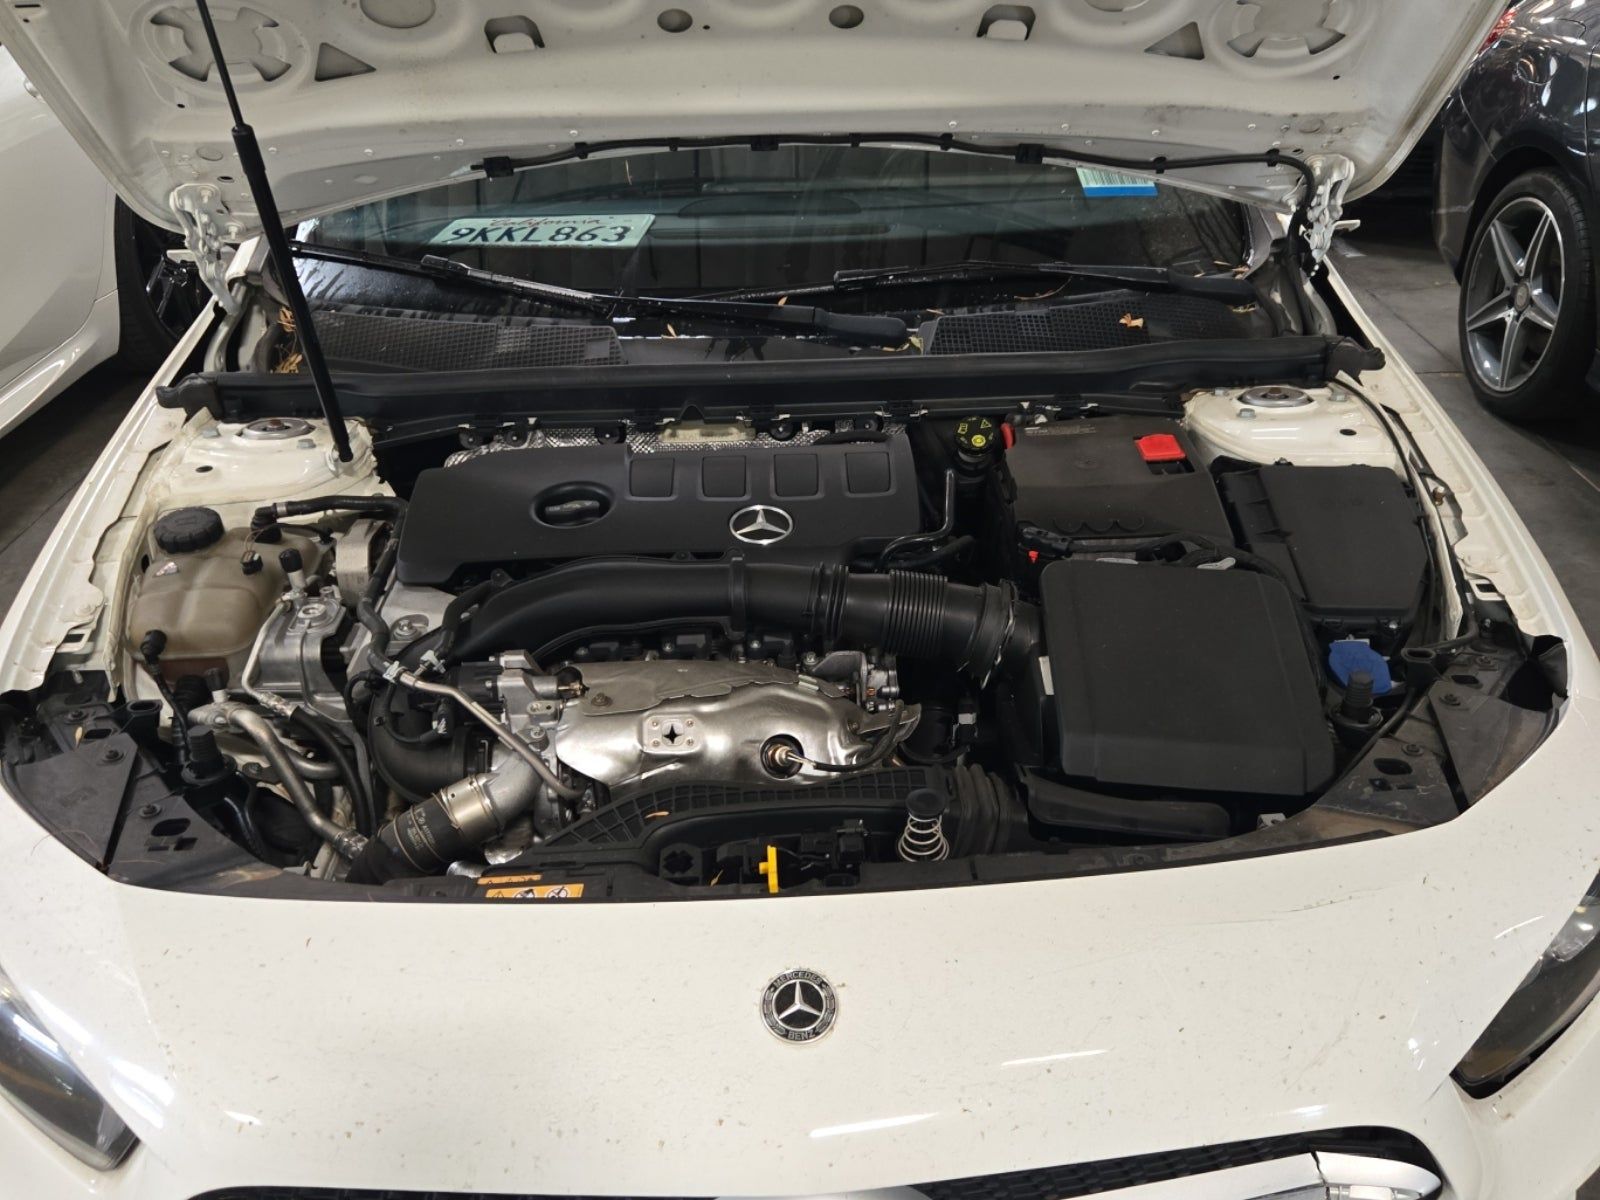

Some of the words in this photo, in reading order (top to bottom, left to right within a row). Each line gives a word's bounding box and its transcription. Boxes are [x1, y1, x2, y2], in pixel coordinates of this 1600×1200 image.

[444, 226, 631, 243] 9KKL863
[774, 972, 822, 987] MERCEDES
[787, 1030, 816, 1040] BENZ
